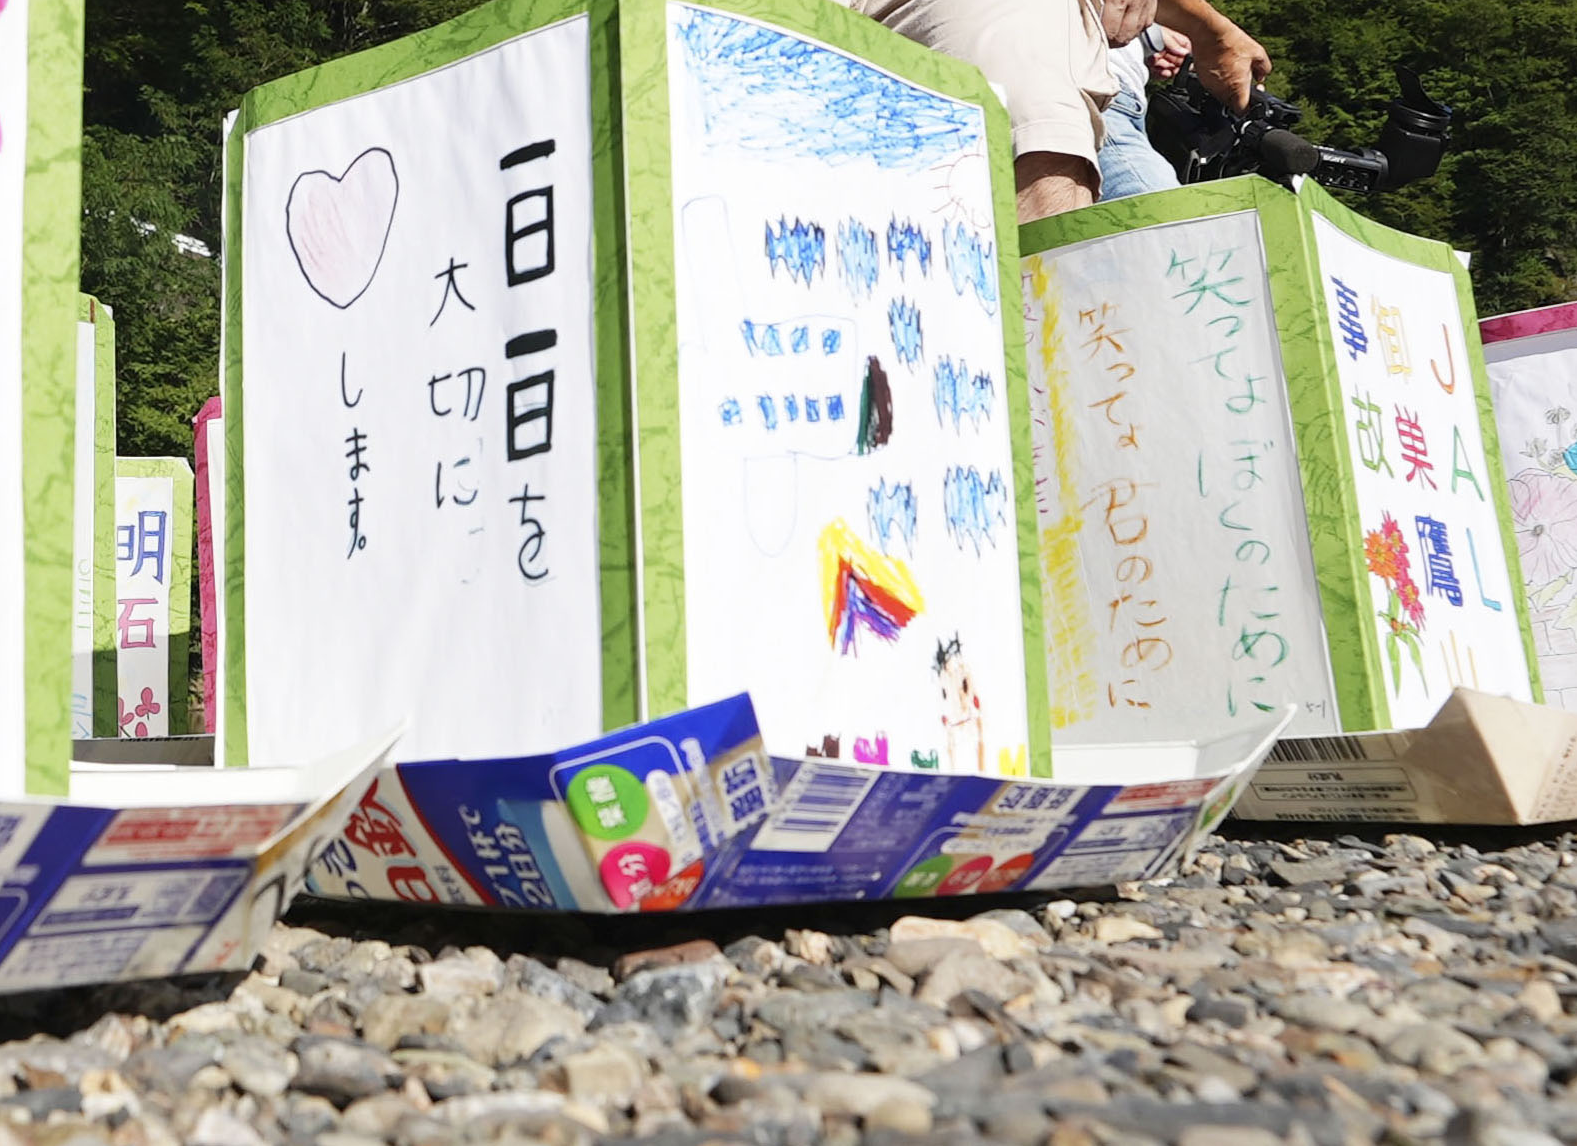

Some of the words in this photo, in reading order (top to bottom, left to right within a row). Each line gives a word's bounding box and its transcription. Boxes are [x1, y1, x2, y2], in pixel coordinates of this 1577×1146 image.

[428, 257, 486, 509] 大切に
[500, 139, 557, 581] 一日一日を
[1430, 323, 1503, 612] JAL
[116, 510, 167, 650] 明石
